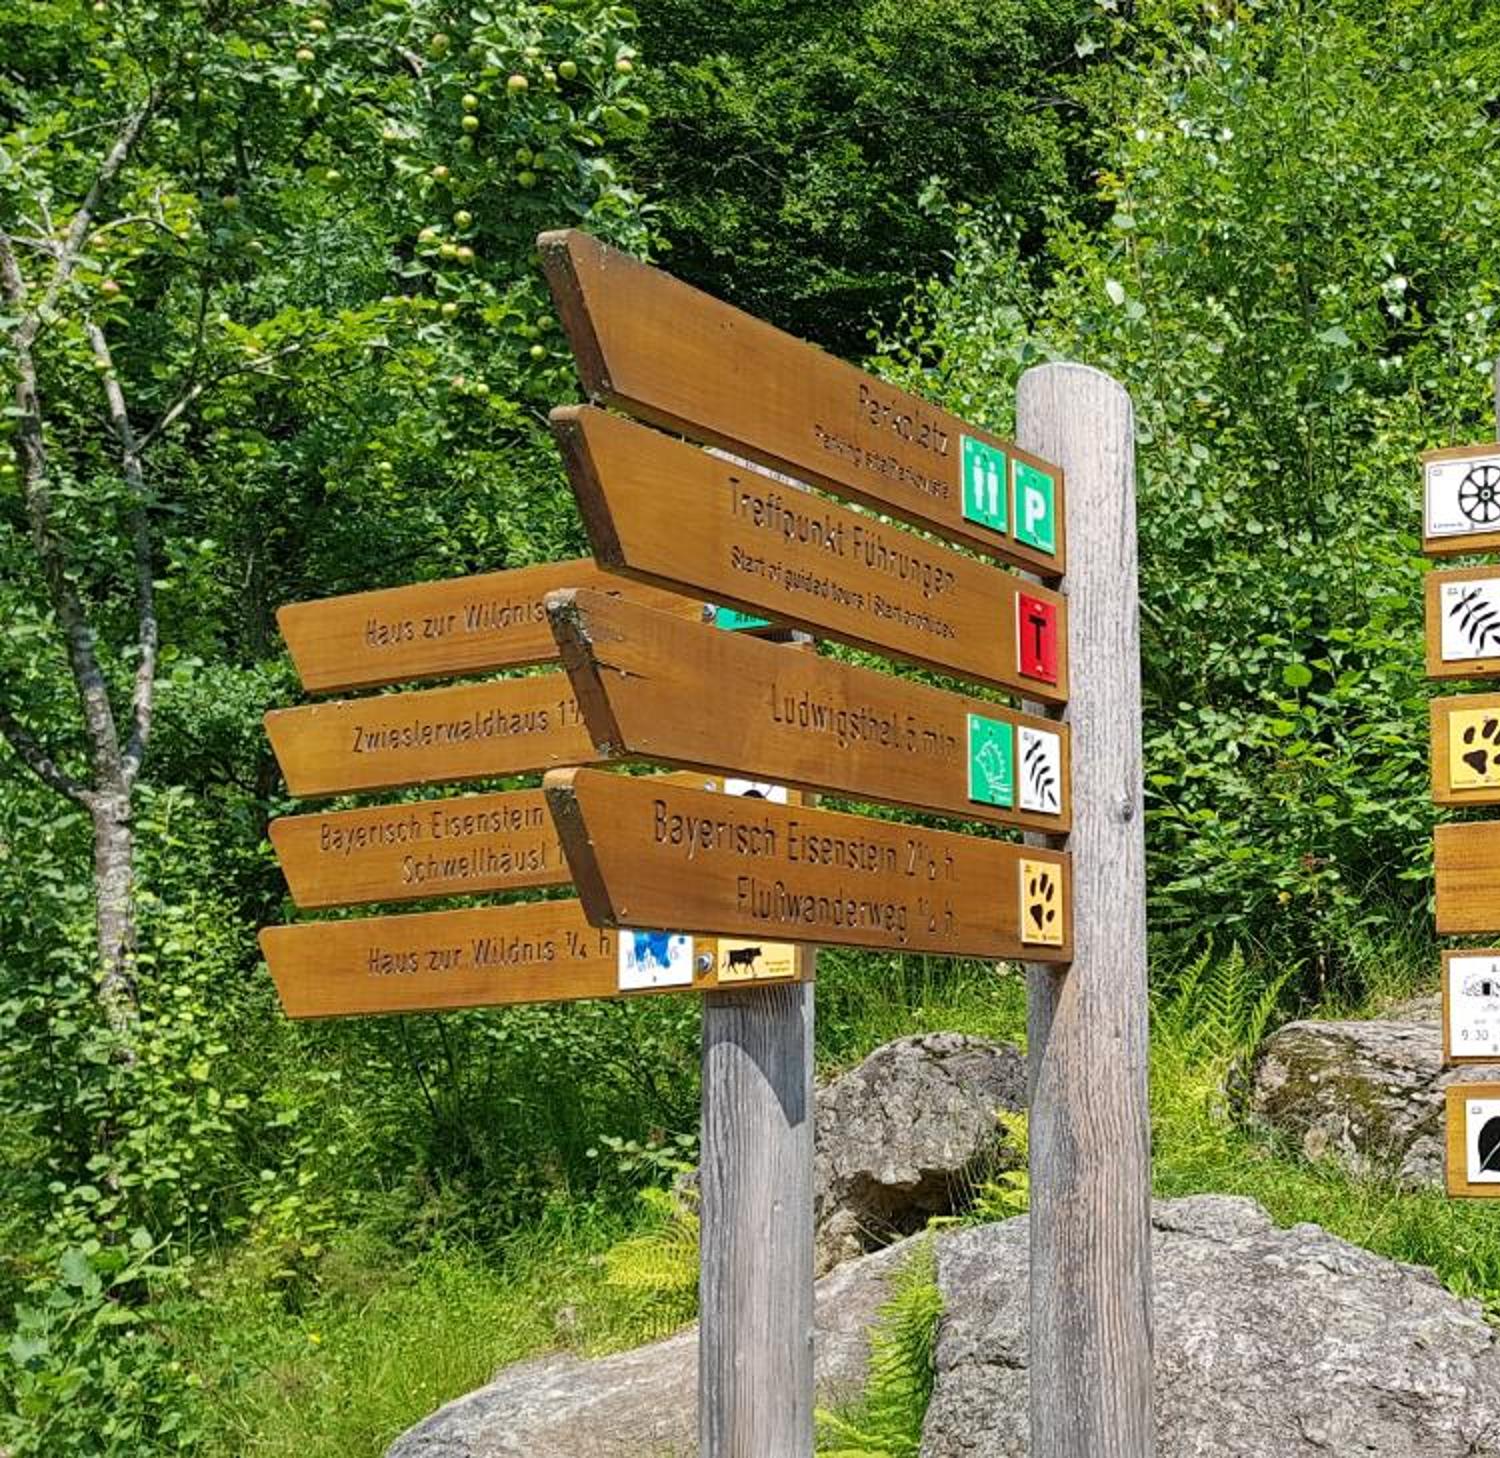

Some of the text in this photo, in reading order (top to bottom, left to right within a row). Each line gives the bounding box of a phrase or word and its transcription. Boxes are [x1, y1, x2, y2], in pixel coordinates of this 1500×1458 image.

[858, 383, 949, 458] Parkplatz
[1025, 487, 1046, 534] P
[728, 477, 956, 600] Treffpunkt Führungen
[364, 597, 548, 647] Haus zur Wildnis
[1028, 614, 1047, 662] T
[352, 707, 549, 754] Zwieslerwaldhaus
[319, 799, 545, 854] Bayerisch Eisenstein
[653, 798, 777, 861] Bayerisch
[787, 820, 898, 872] Eisenstein
[402, 839, 547, 884] Schwellhäusl
[736, 875, 908, 944] Flußwanderweg
[367, 946, 423, 975] Haus
[428, 946, 463, 972] zur
[471, 931, 555, 967] Wildnis
